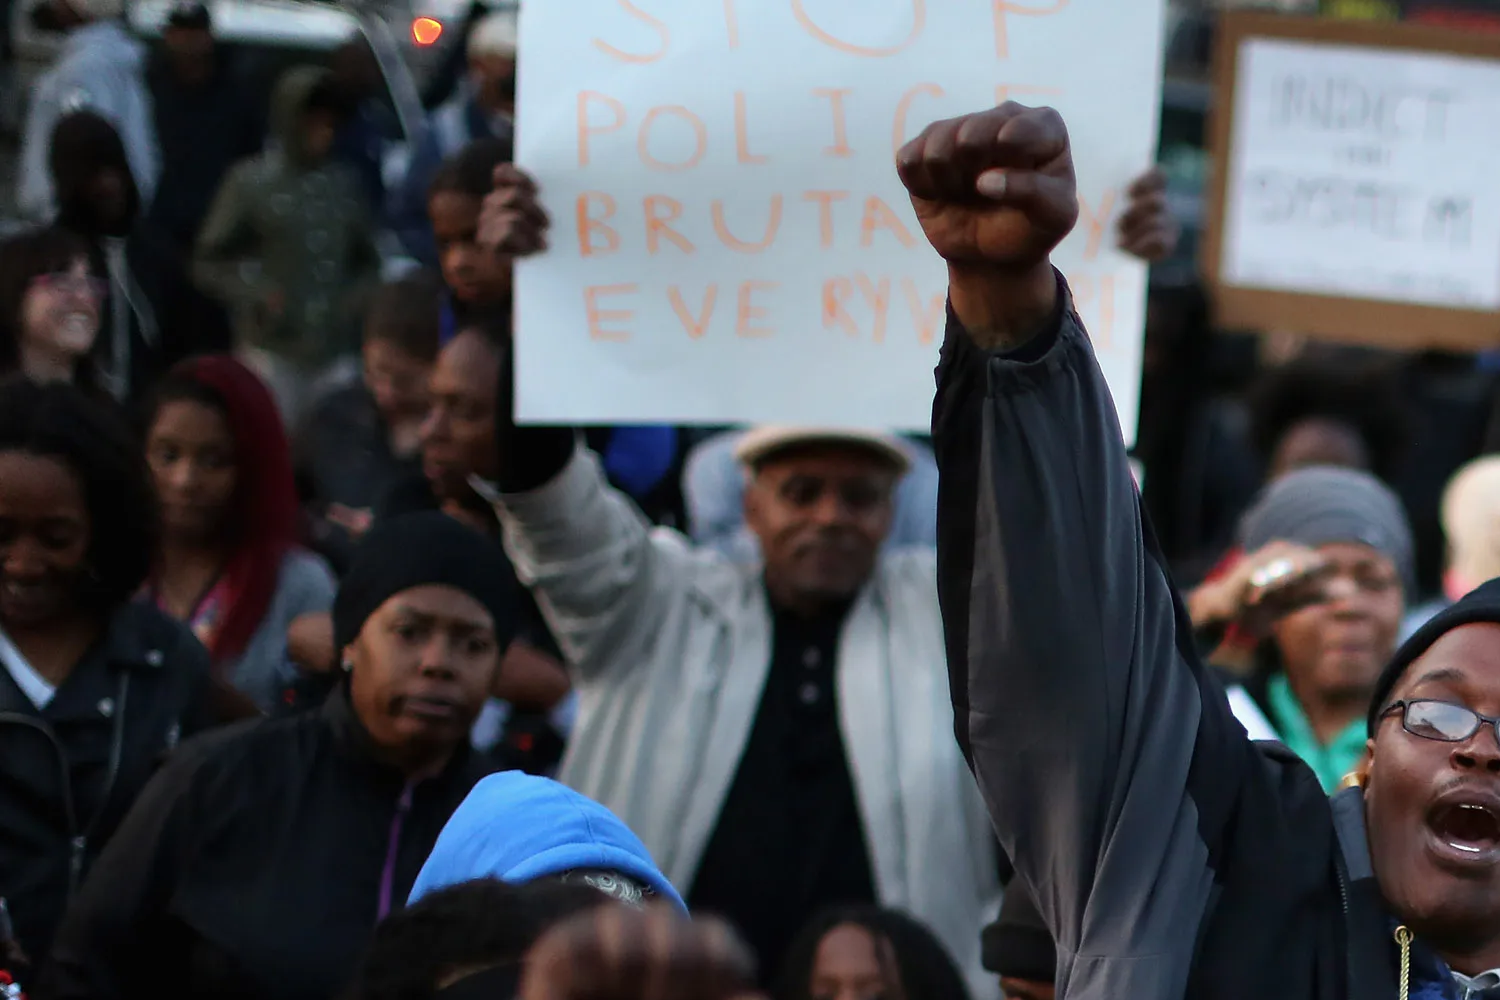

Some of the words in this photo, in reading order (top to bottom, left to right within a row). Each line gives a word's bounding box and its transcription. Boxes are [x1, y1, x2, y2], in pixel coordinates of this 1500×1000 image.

[576, 82, 1064, 172] POLIC
[576, 189, 1116, 259] BRUTAY
[584, 271, 1136, 352] EVERYWE
